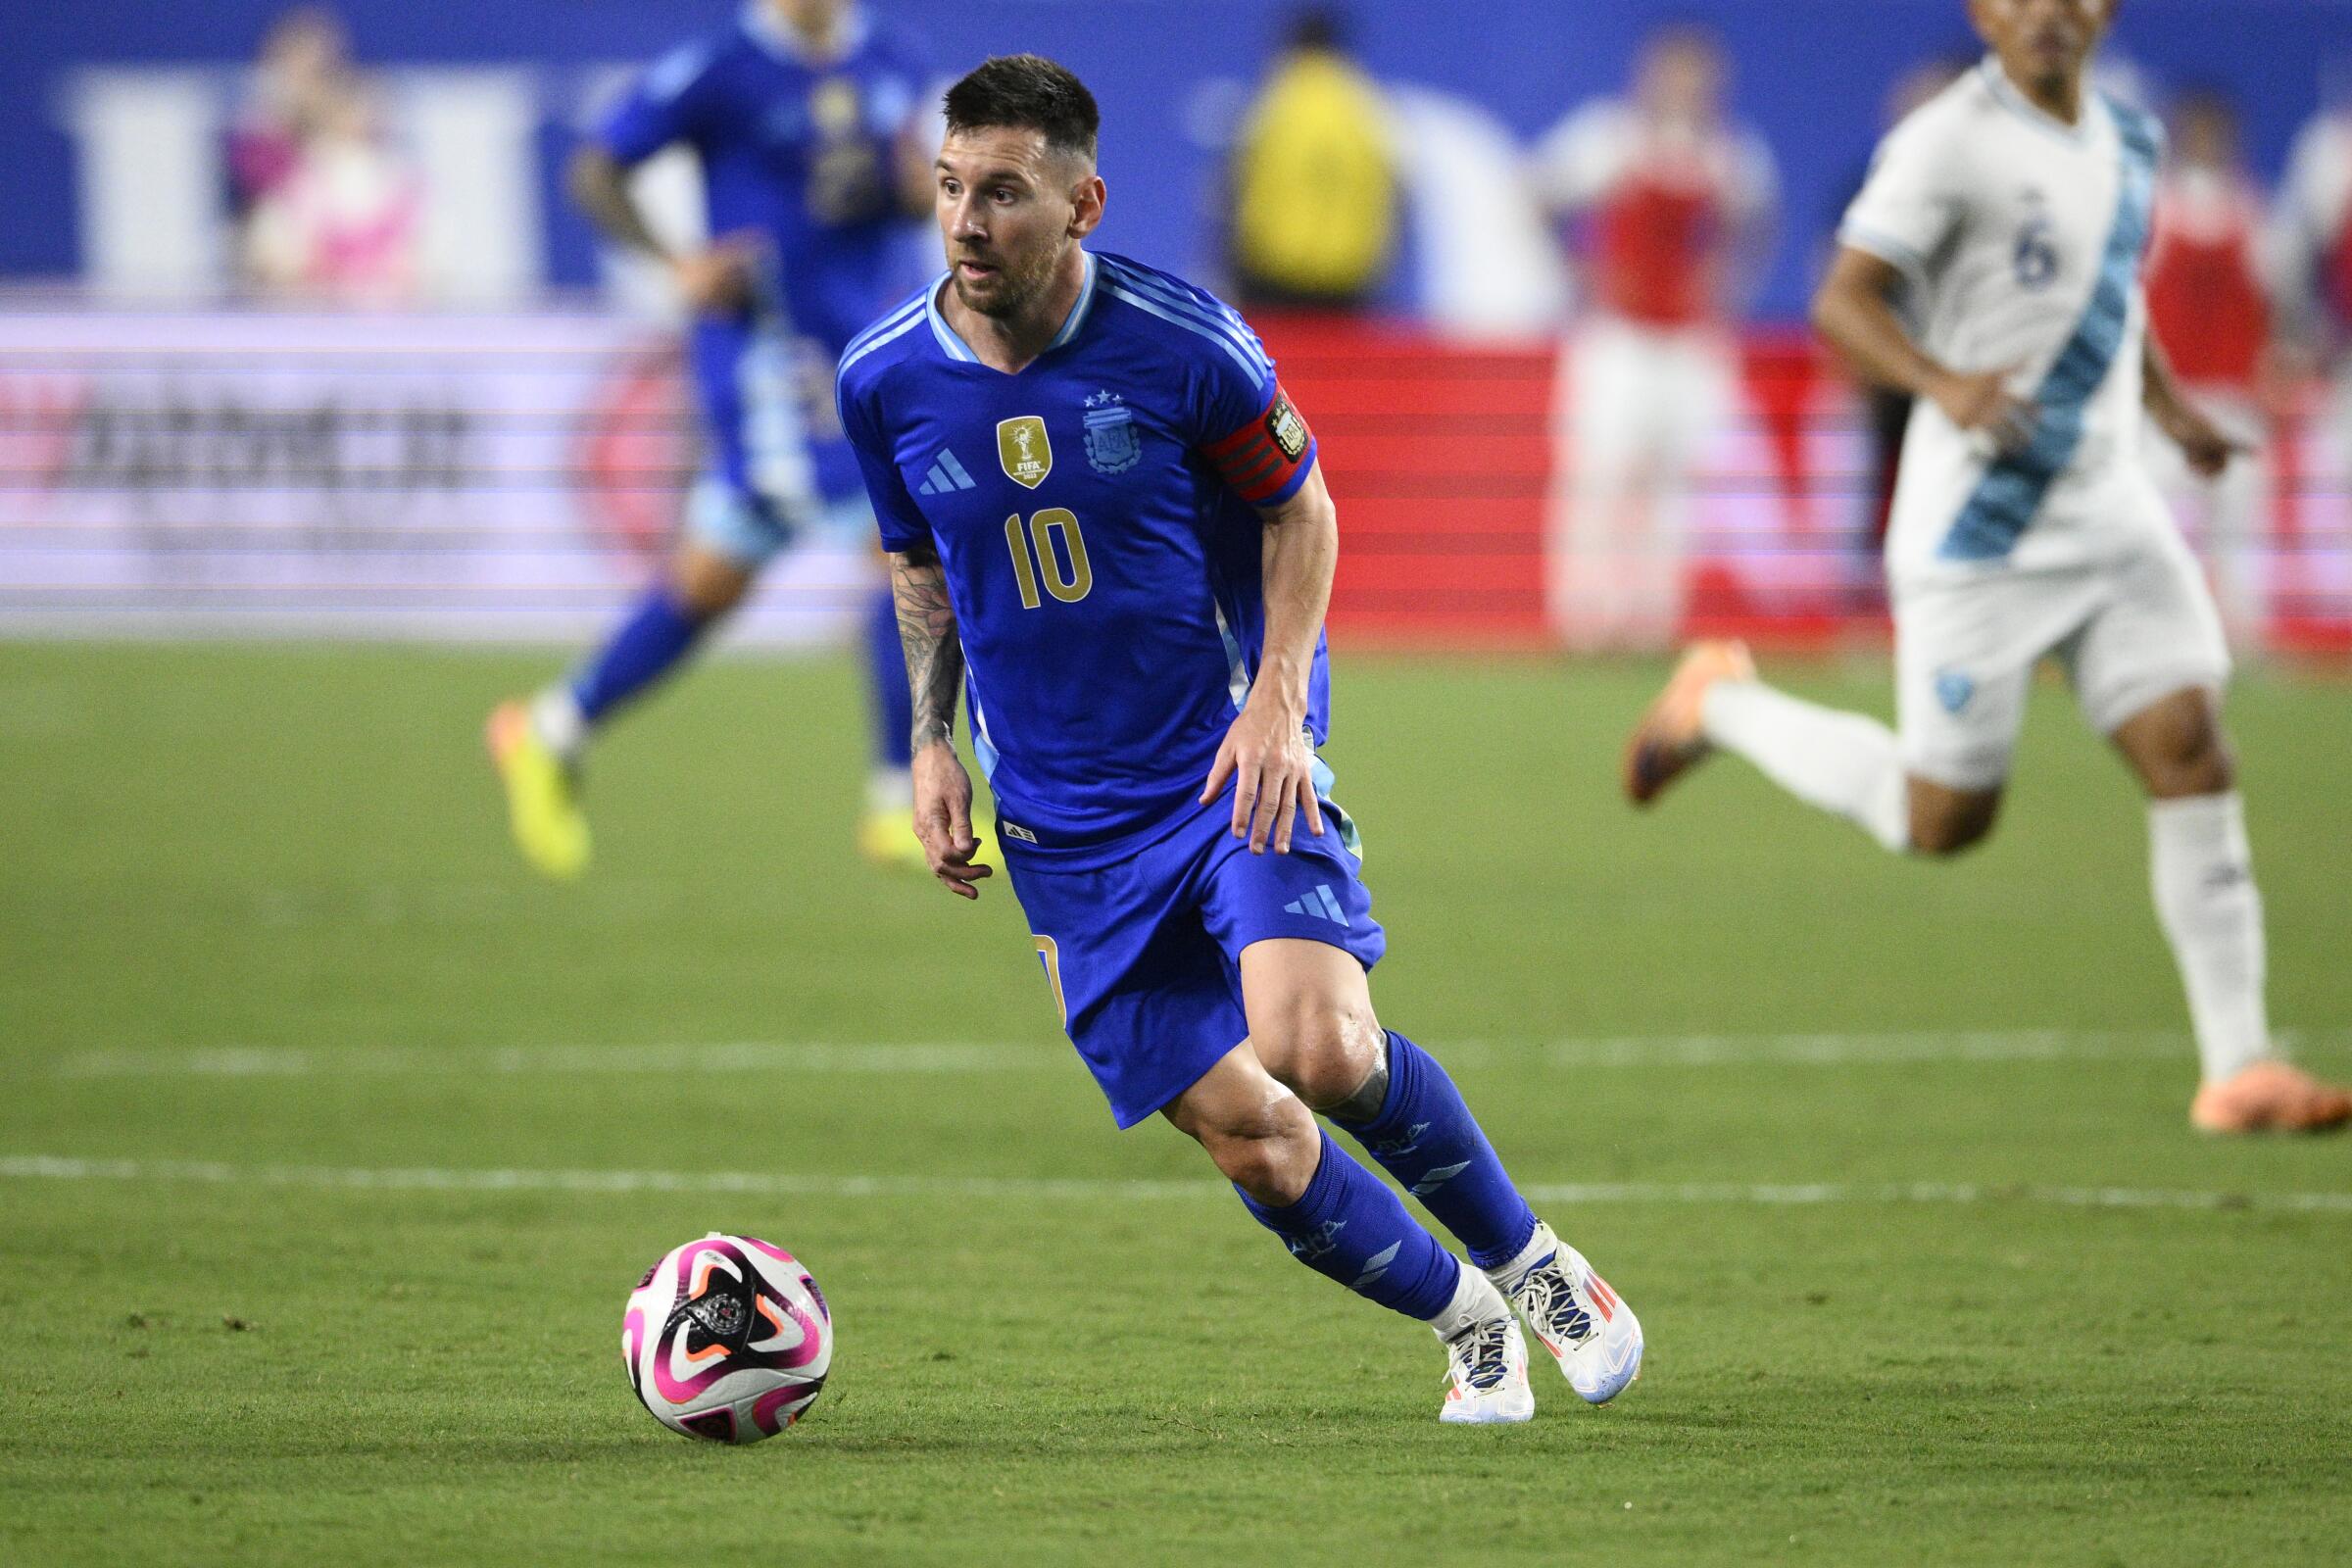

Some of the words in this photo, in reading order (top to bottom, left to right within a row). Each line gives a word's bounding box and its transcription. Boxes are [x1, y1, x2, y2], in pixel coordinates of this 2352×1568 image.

[2014, 217, 2059, 293] 6
[1017, 460, 1041, 472] FIFA
[1004, 507, 1093, 610] 10
